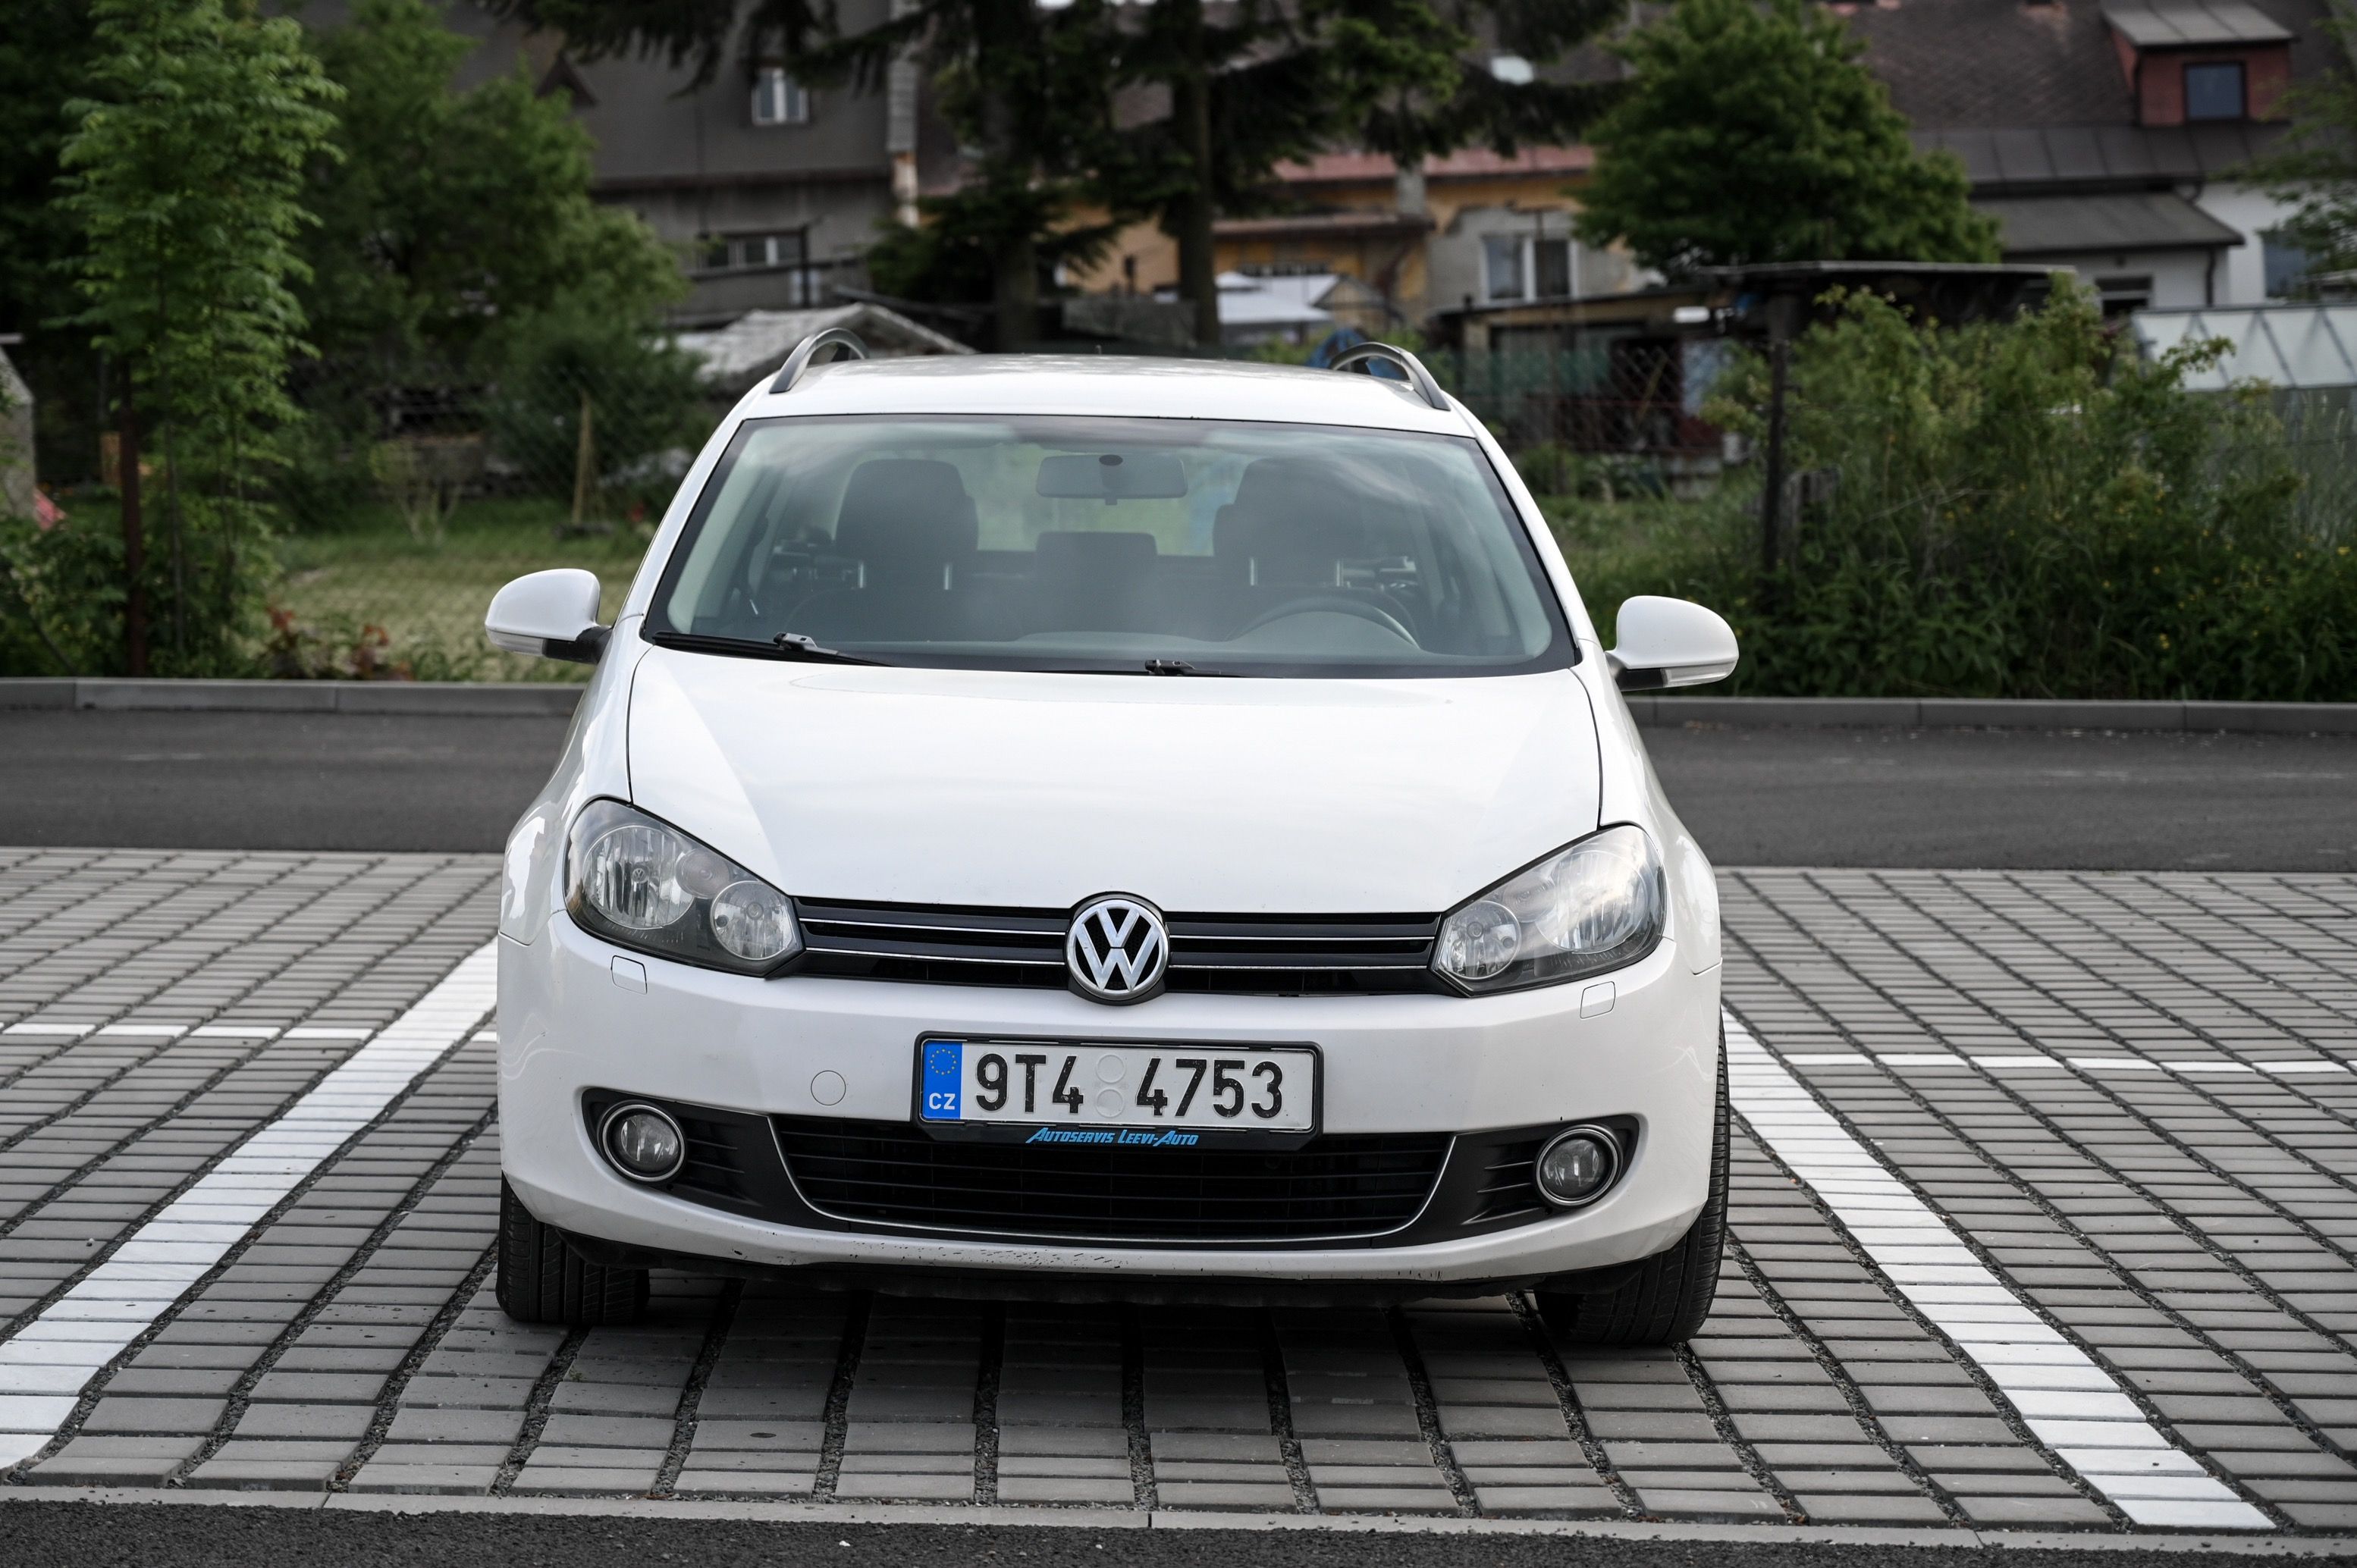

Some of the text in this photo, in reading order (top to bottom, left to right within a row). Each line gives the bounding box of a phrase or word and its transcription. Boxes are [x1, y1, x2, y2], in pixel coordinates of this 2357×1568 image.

[1074, 907, 1160, 991] VW
[928, 1092, 956, 1110] CZ
[976, 1053, 1283, 1119] 9T4 4753
